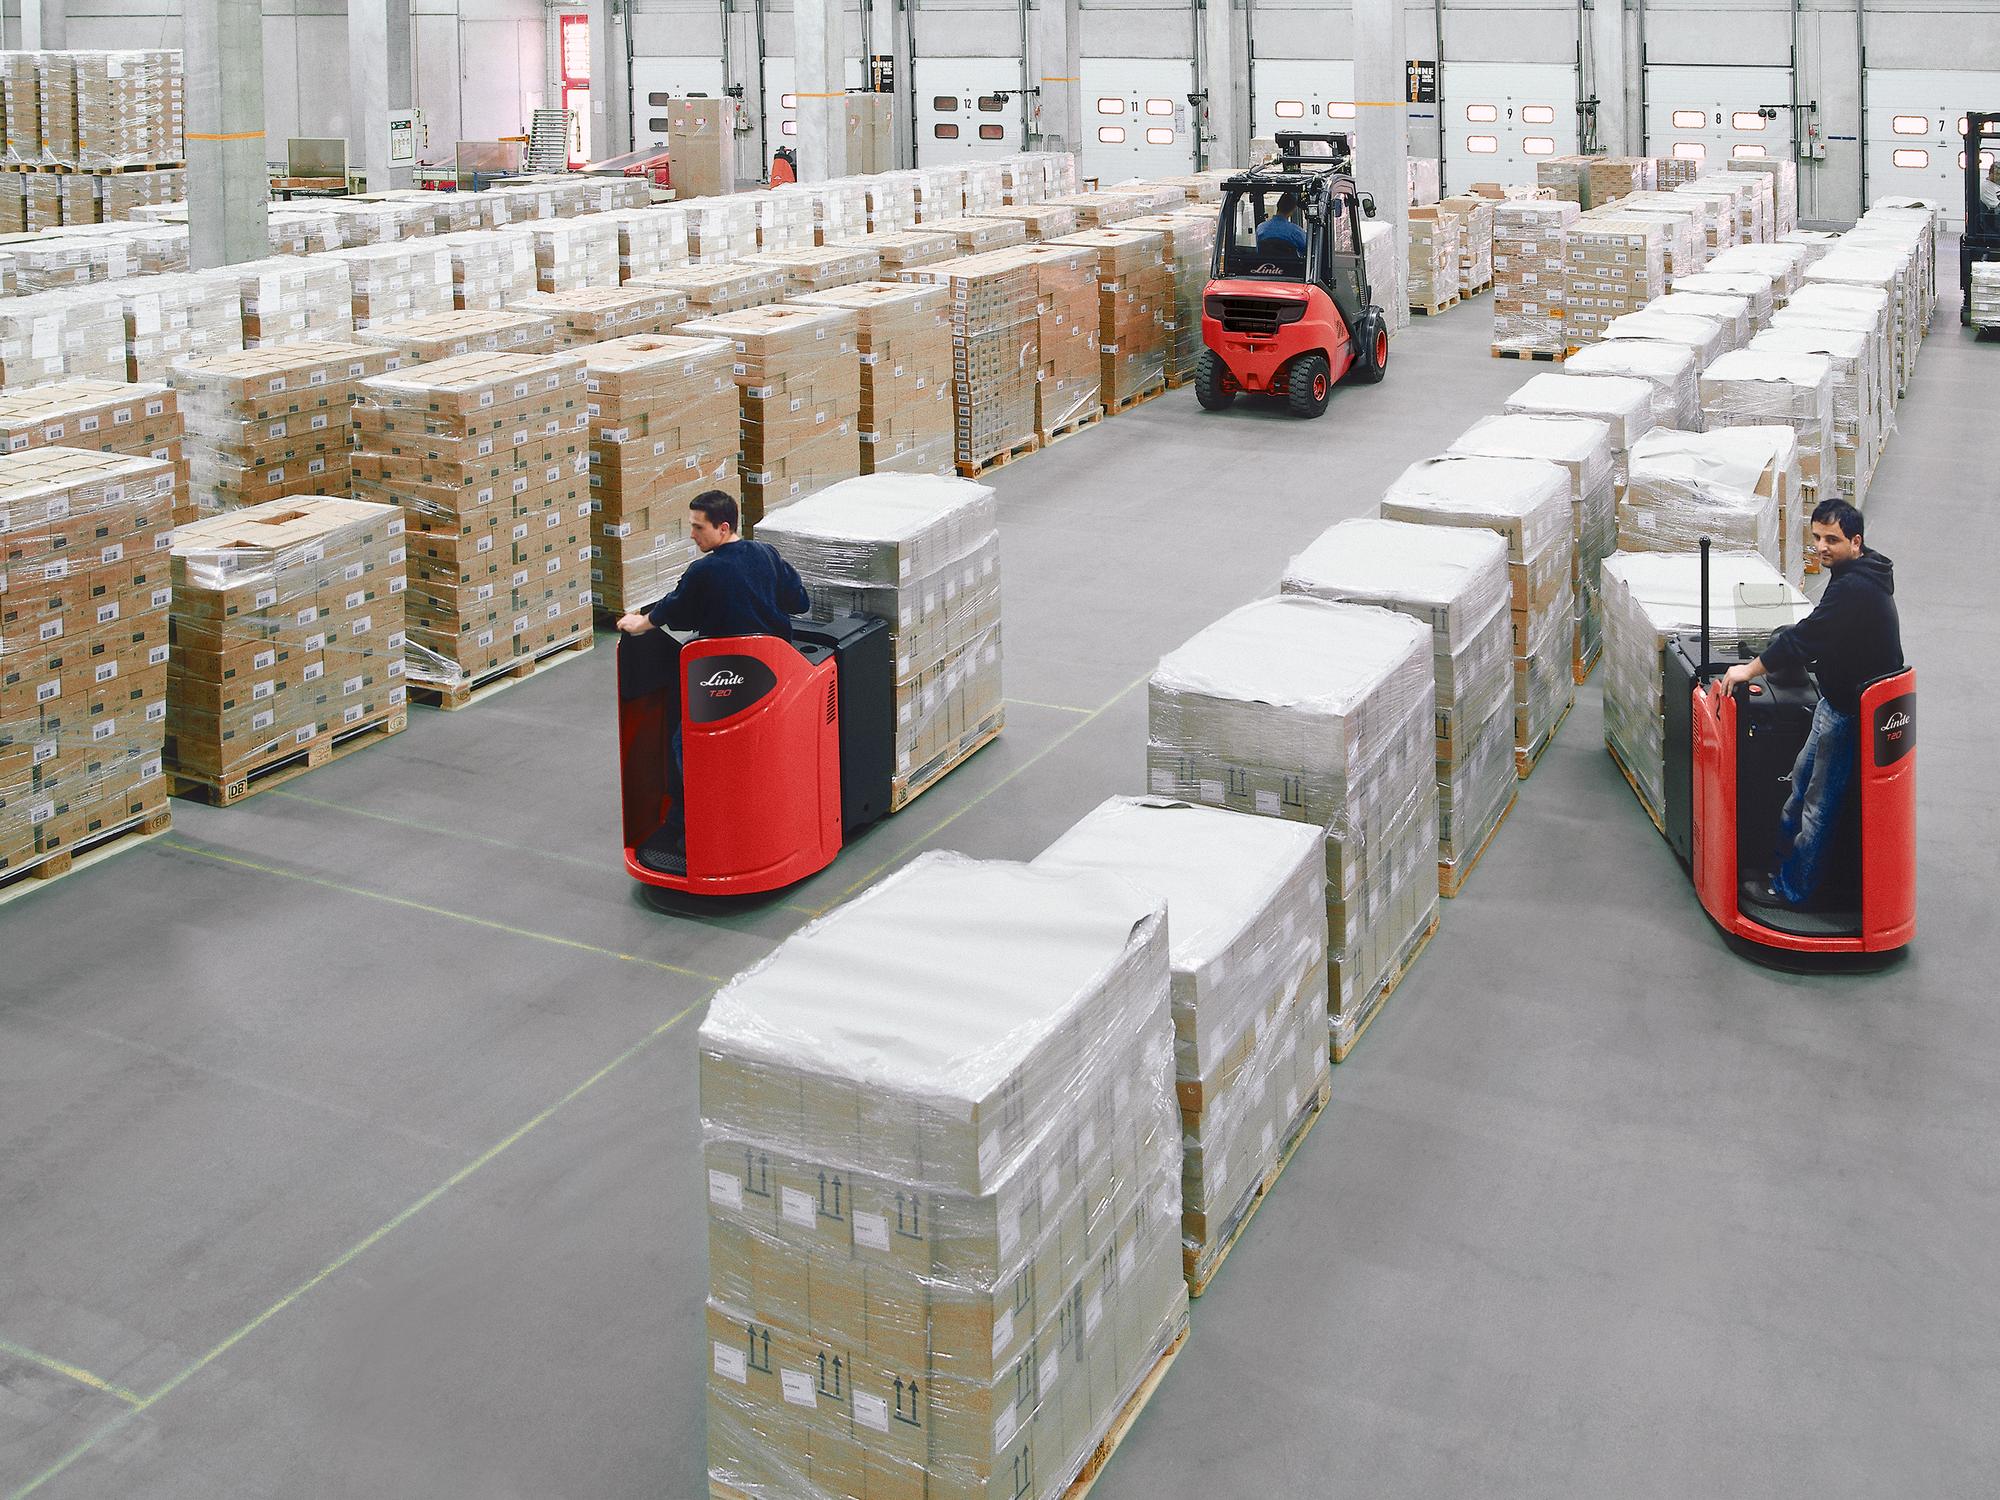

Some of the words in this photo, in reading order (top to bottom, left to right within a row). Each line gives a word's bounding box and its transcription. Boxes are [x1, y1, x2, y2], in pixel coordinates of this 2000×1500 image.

[1408, 67, 1434, 75] OHNE
[963, 99, 971, 108] 12
[1131, 102, 1138, 111] 11
[1311, 104, 1320, 115] 10
[1507, 108, 1513, 119] 9
[1716, 112, 1722, 124] 8
[1939, 120, 1945, 132] 7
[1250, 263, 1284, 274] Linde
[700, 670, 744, 686] Linde
[709, 689, 732, 697] T20
[1881, 712, 1910, 731] Linde
[1887, 730, 1902, 741] T20
